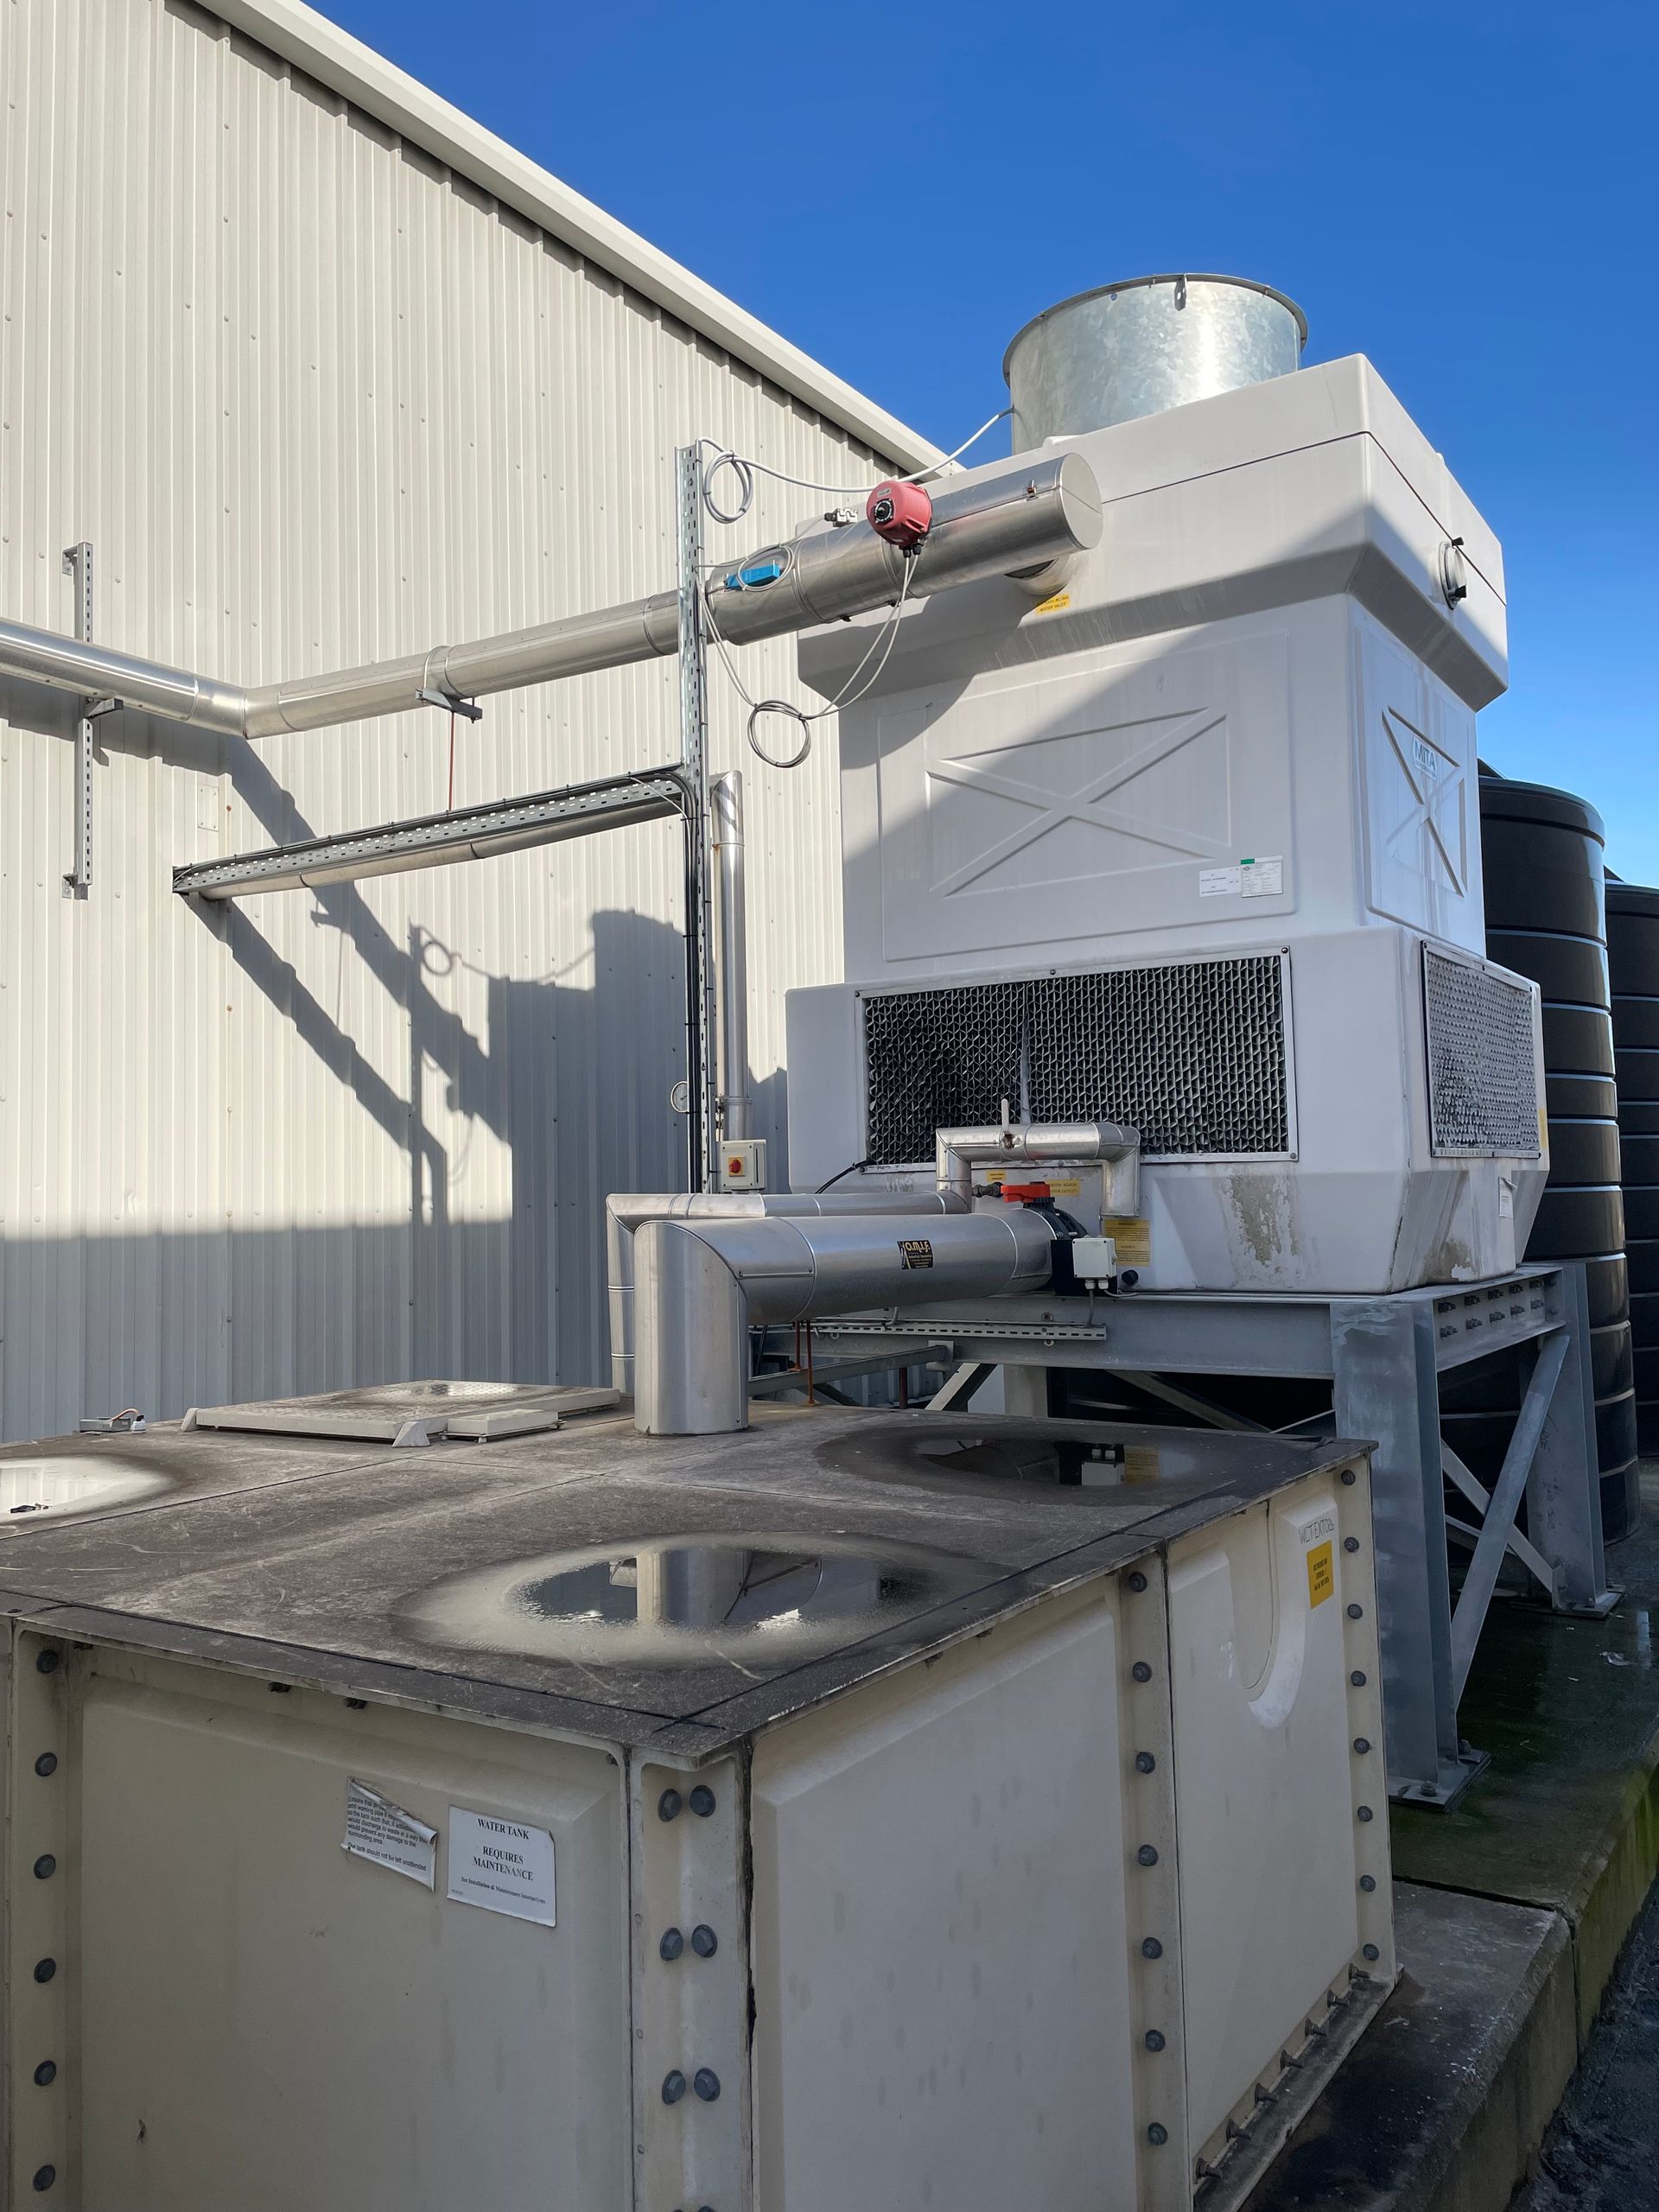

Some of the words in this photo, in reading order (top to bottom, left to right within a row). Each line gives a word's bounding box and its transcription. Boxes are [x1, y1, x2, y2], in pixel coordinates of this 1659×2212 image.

[1414, 739, 1436, 772] MITA
[361, 1820, 381, 1830] discharge
[477, 1818, 505, 1834] WATER
[506, 1826, 530, 1840] TANK
[347, 1831, 372, 1843] surrounding
[360, 1827, 378, 1836] prevent
[377, 1831, 385, 1840] any
[385, 1834, 404, 1845] damage
[356, 1845, 365, 1853] tank
[366, 1848, 381, 1857] should
[403, 1859, 427, 1872] unattended
[483, 1846, 524, 1865] REQUIRES
[473, 1856, 534, 1882] MAINTENANCE
